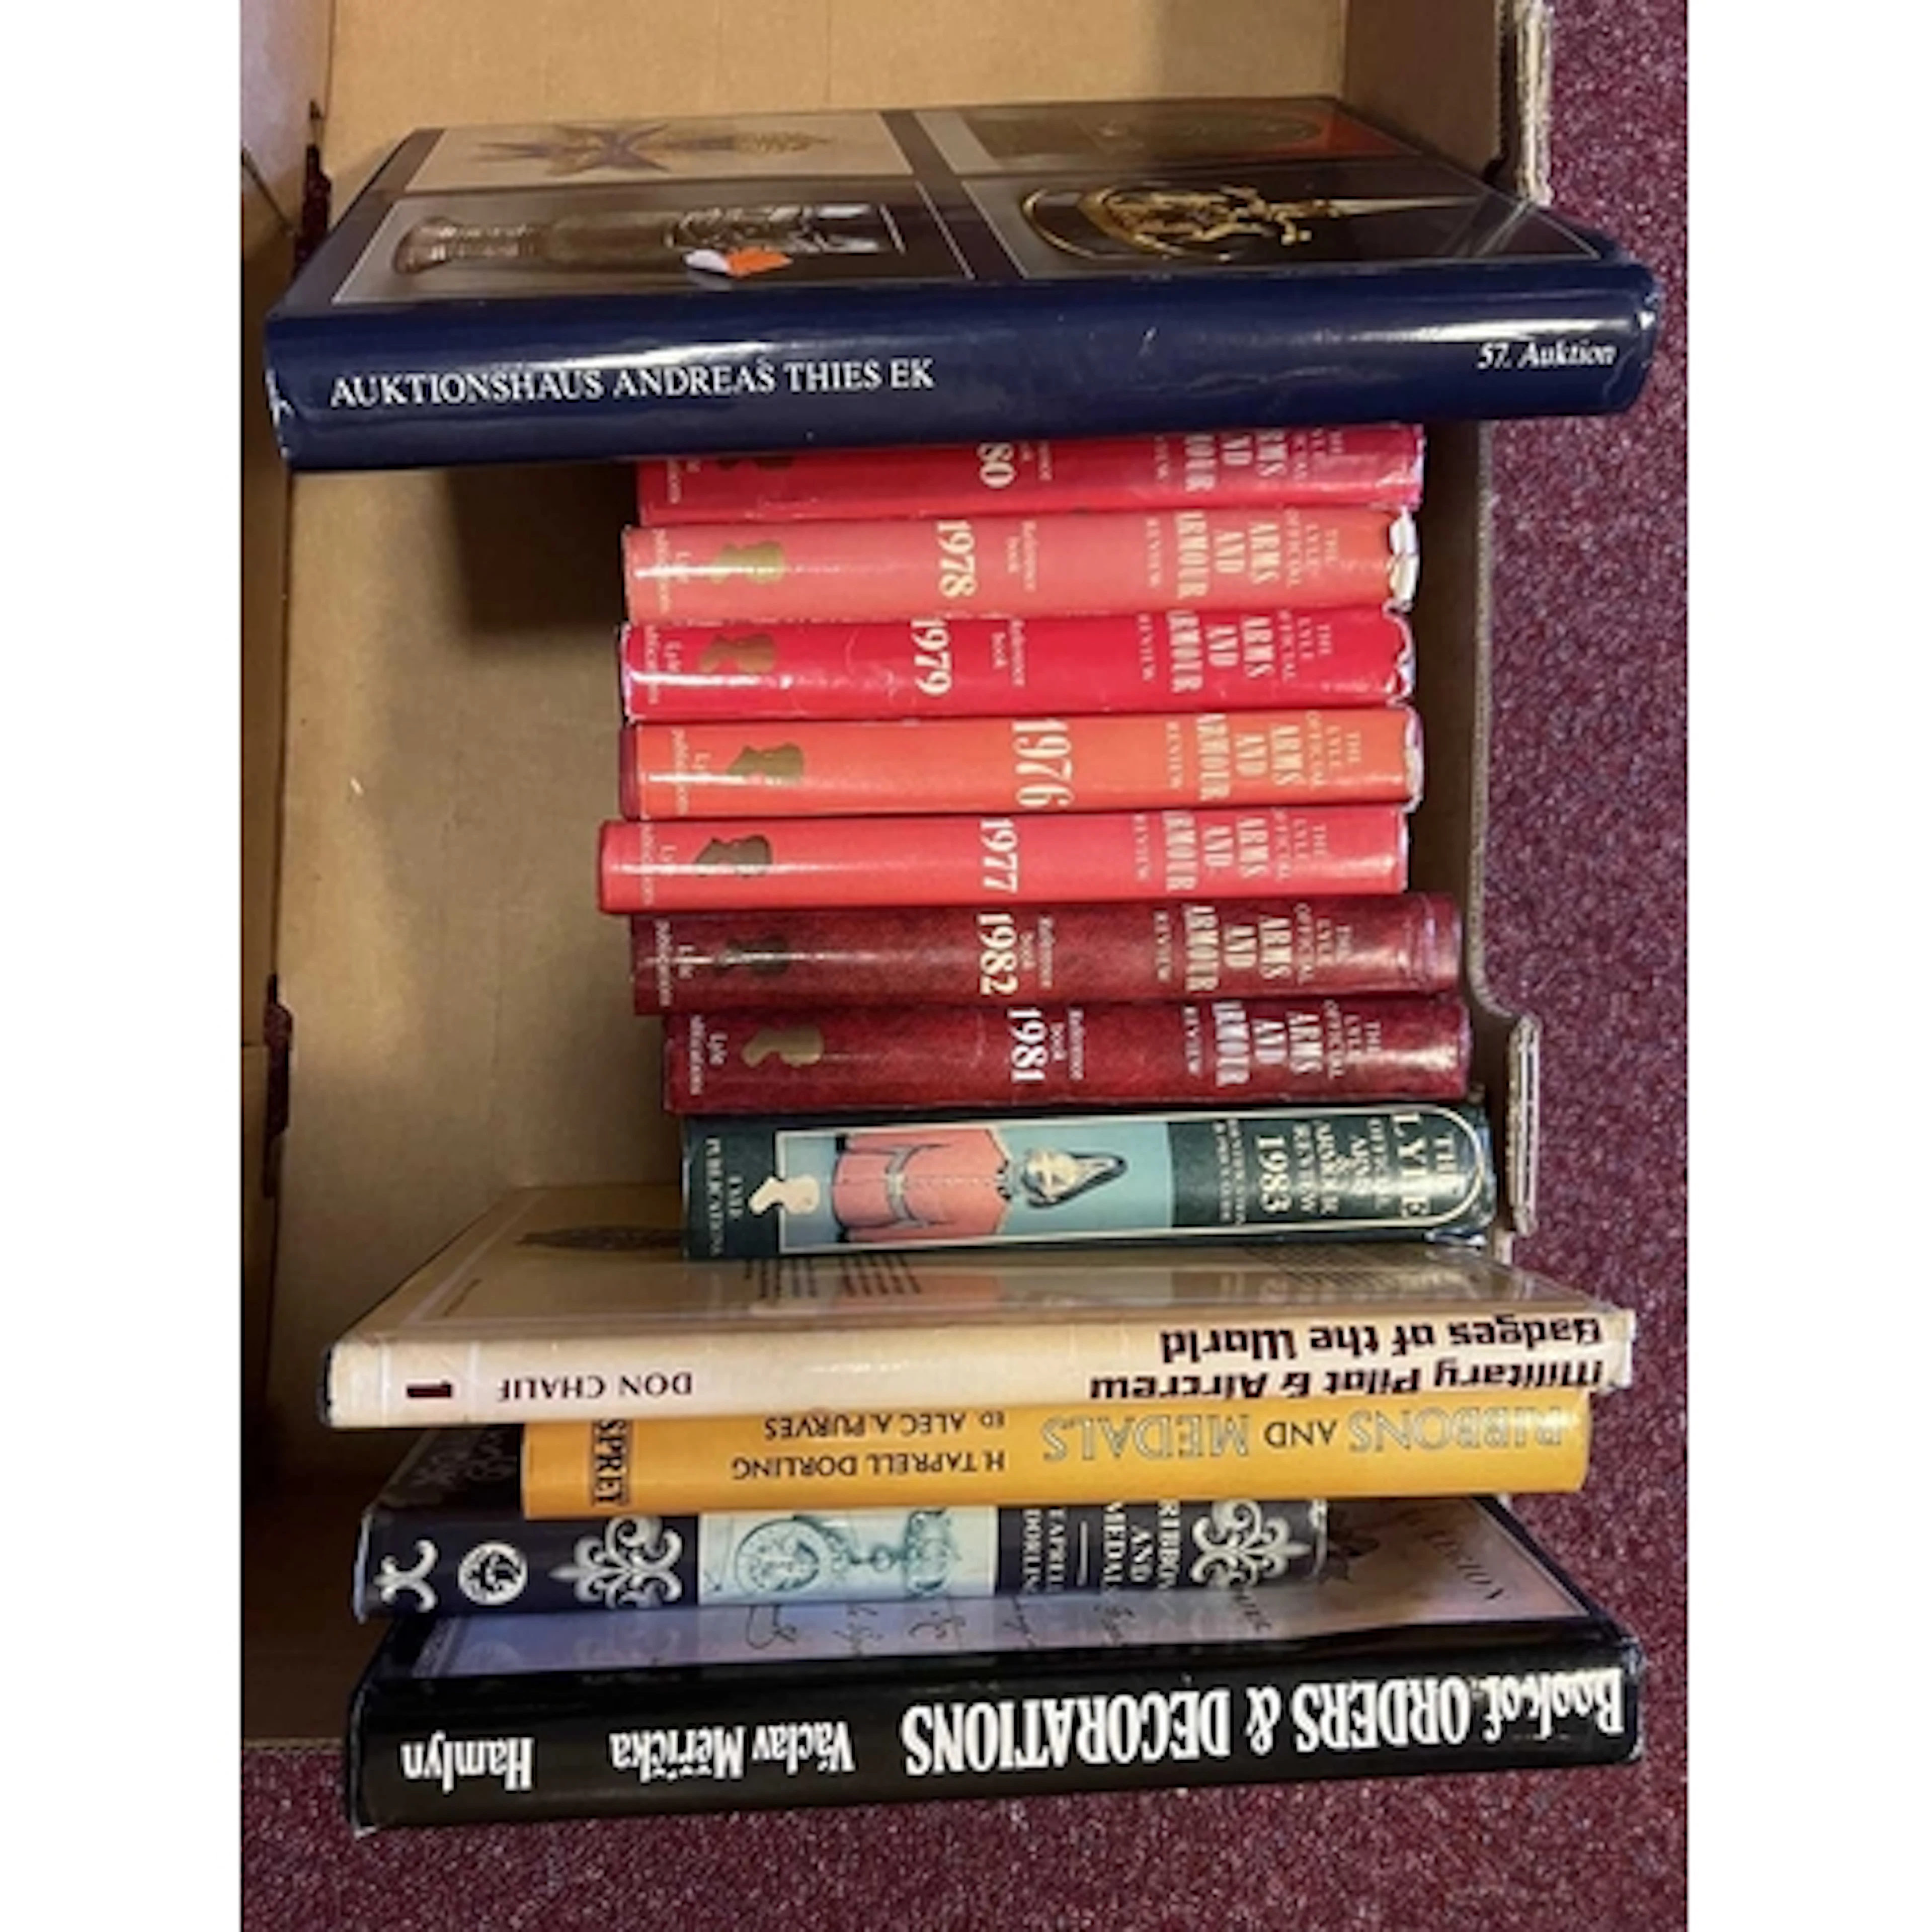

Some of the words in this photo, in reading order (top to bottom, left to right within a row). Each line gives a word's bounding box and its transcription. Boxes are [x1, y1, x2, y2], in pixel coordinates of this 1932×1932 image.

[1516, 339, 1617, 368] Auktion
[330, 369, 602, 407] AUKTIONSHAUS
[613, 361, 776, 396] ANDREAS
[784, 359, 882, 391] THIES
[889, 357, 934, 388] EK
[977, 442, 1018, 489] 80
[1221, 433, 1253, 465] ND
[1257, 428, 1286, 477] RMS
[936, 520, 978, 598] 1978
[1006, 535, 1021, 574] book
[1021, 519, 1038, 593] Reference
[1146, 517, 1161, 589] REVIEW
[1175, 511, 1208, 601] ARMOUR
[1212, 530, 1245, 574] AND
[1249, 522, 1280, 584] ARMS
[1324, 528, 1339, 564] THE
[910, 617, 952, 696] 1979
[1206, 625, 1239, 668] AND
[1241, 615, 1274, 679] ARMS
[1317, 623, 1332, 656] THE
[1012, 720, 1074, 808] 1976
[1166, 721, 1183, 790] REVIEW
[1196, 713, 1230, 801] ARMOUR
[1236, 733, 1267, 776] AND
[1270, 725, 1304, 786] ARMS
[1346, 731, 1360, 764] THE
[980, 818, 1018, 893] 1977
[1201, 825, 1234, 868] AND
[1237, 816, 1268, 879] ARMS
[1313, 822, 1327, 856] THE
[978, 913, 1018, 995] 1982
[1019, 932, 1036, 971] book
[1037, 916, 1056, 990] Reference
[1155, 910, 1172, 982] REVIEW
[1183, 904, 1219, 992] ARMOUR
[1224, 924, 1256, 968] AND
[1259, 916, 1292, 980] ARMS
[1008, 1006, 1048, 1084] 1981
[1050, 1022, 1067, 1062] book
[1068, 1008, 1084, 1081] Reference
[1184, 1006, 1201, 1076] REVIEW
[1213, 1001, 1250, 1087] ARMOUR
[1253, 1018, 1286, 1065] AND
[1286, 1011, 1322, 1075] ARMS
[1257, 1135, 1292, 1213] 1983
[1160, 1327, 1297, 1362] World
[1310, 1324, 1379, 1357] the
[1393, 1323, 1433, 1355] of
[1448, 1314, 1602, 1350] Badges
[498, 1374, 605, 1402] CHALIF
[618, 1373, 692, 1397] DON
[1090, 1371, 1267, 1400] Aircrew
[1282, 1371, 1310, 1397] &
[1325, 1365, 1420, 1395] Pilot
[764, 1412, 868, 1442] PURVES
[900, 1413, 965, 1438] ALEC
[1041, 1413, 1250, 1461] MEDALS
[1264, 1420, 1337, 1448] AND
[1349, 1407, 1565, 1452] RIBBONS
[593, 1419, 629, 1505] SPREY
[732, 1454, 857, 1480] DORLING
[867, 1451, 978, 1477] TAPRELL
[1131, 1523, 1154, 1583] AND
[1245, 1685, 1281, 1756] &
[1291, 1675, 1472, 1754] ORDERS
[1482, 1673, 1520, 1743] of
[1524, 1666, 1623, 1742] Book
[751, 1720, 855, 1777] Václav
[901, 1686, 1231, 1777] DECORATIONS
[400, 1729, 534, 1793] Hamlyn
